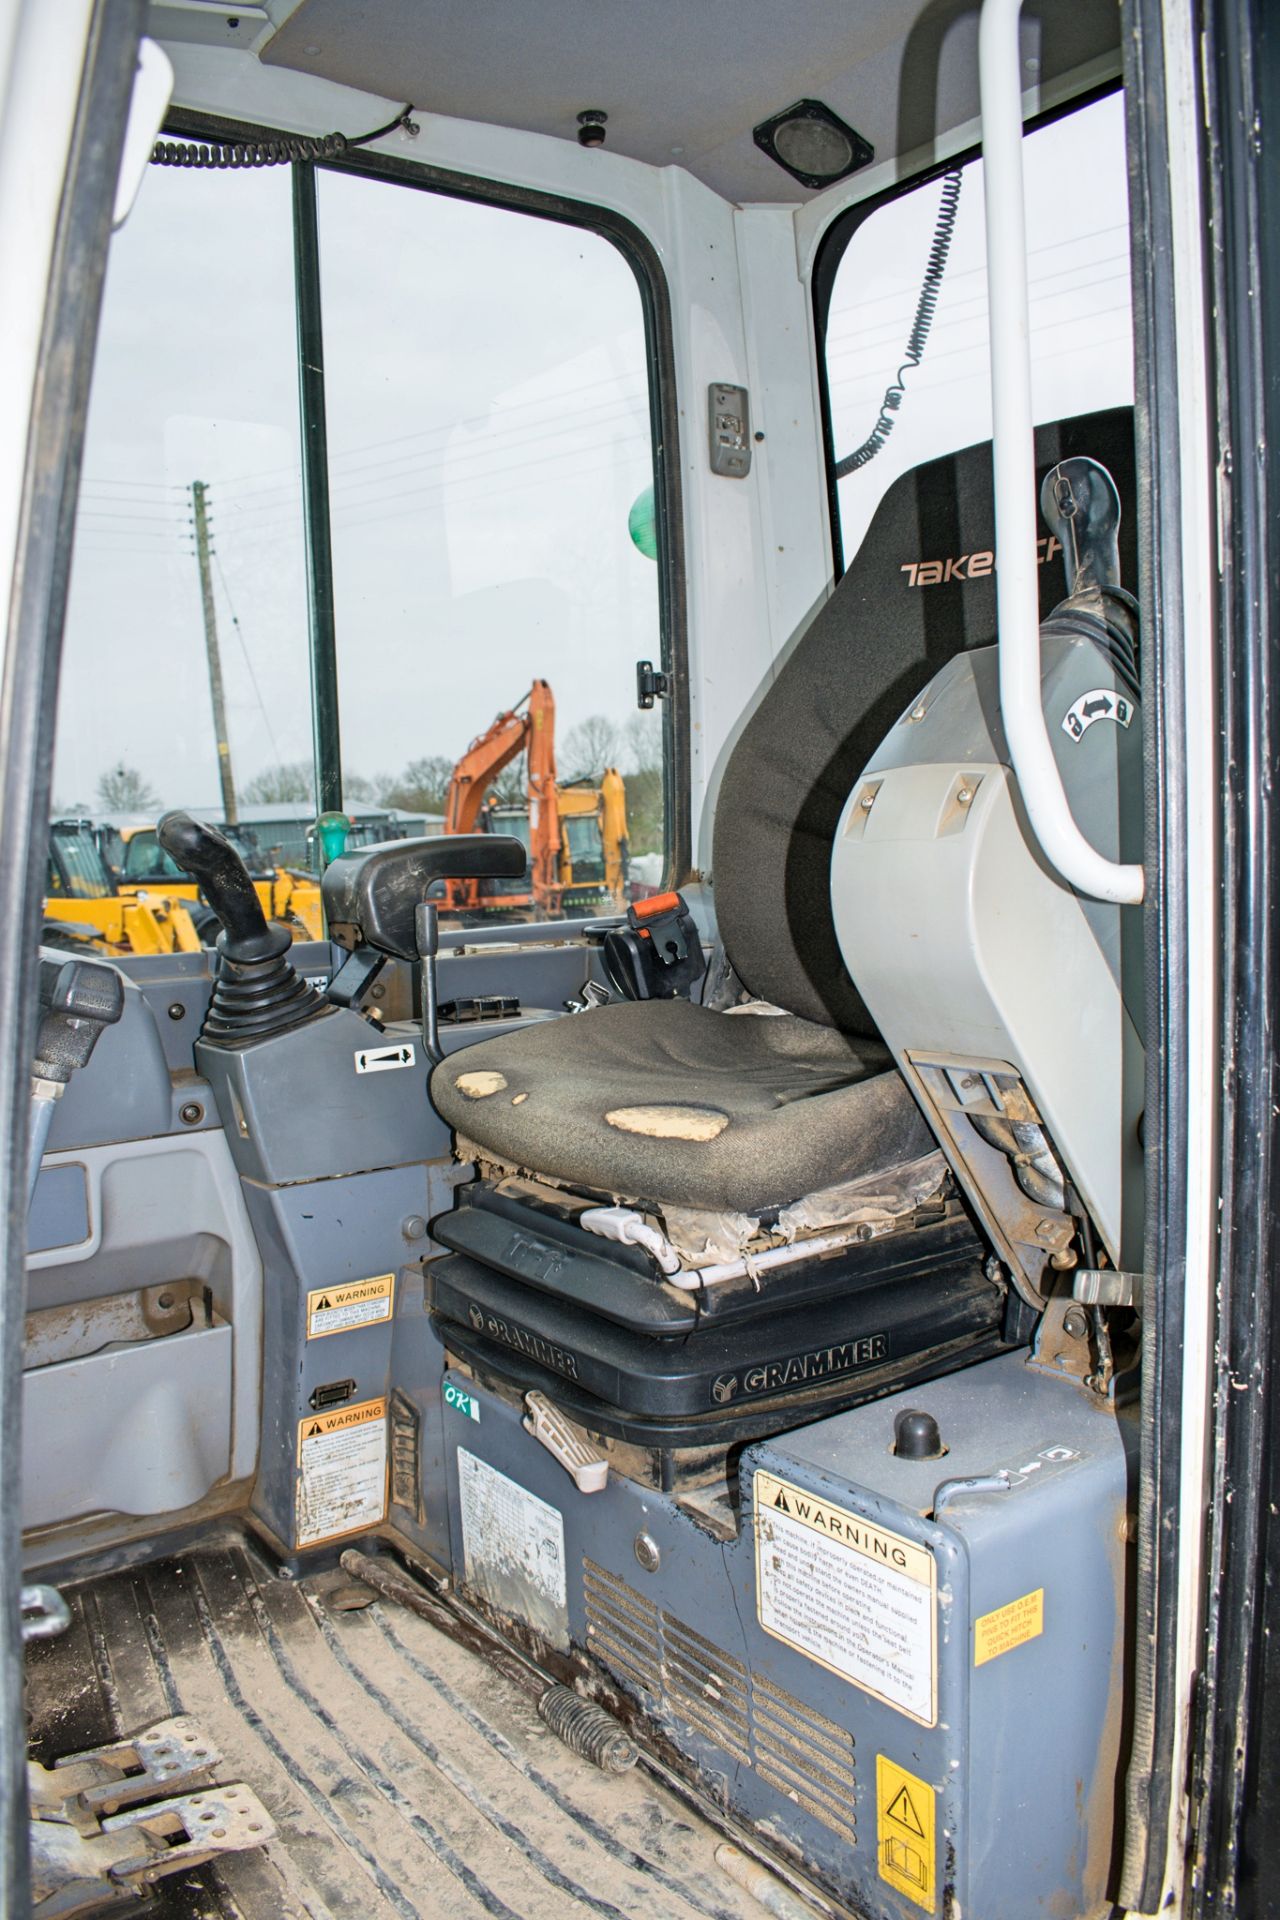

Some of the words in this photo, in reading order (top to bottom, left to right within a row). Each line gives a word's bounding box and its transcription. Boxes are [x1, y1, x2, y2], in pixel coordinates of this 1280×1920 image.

[335, 1285, 385, 1303] WARNING
[485, 1314, 578, 1379] GRAMMER
[744, 1333, 888, 1393] GRAMMER
[445, 1387, 468, 1413] OK
[326, 1406, 381, 1429] WARNING
[795, 1499, 907, 1568] WARNING
[999, 1618, 1008, 1629] TO
[987, 1646, 997, 1656] TO
